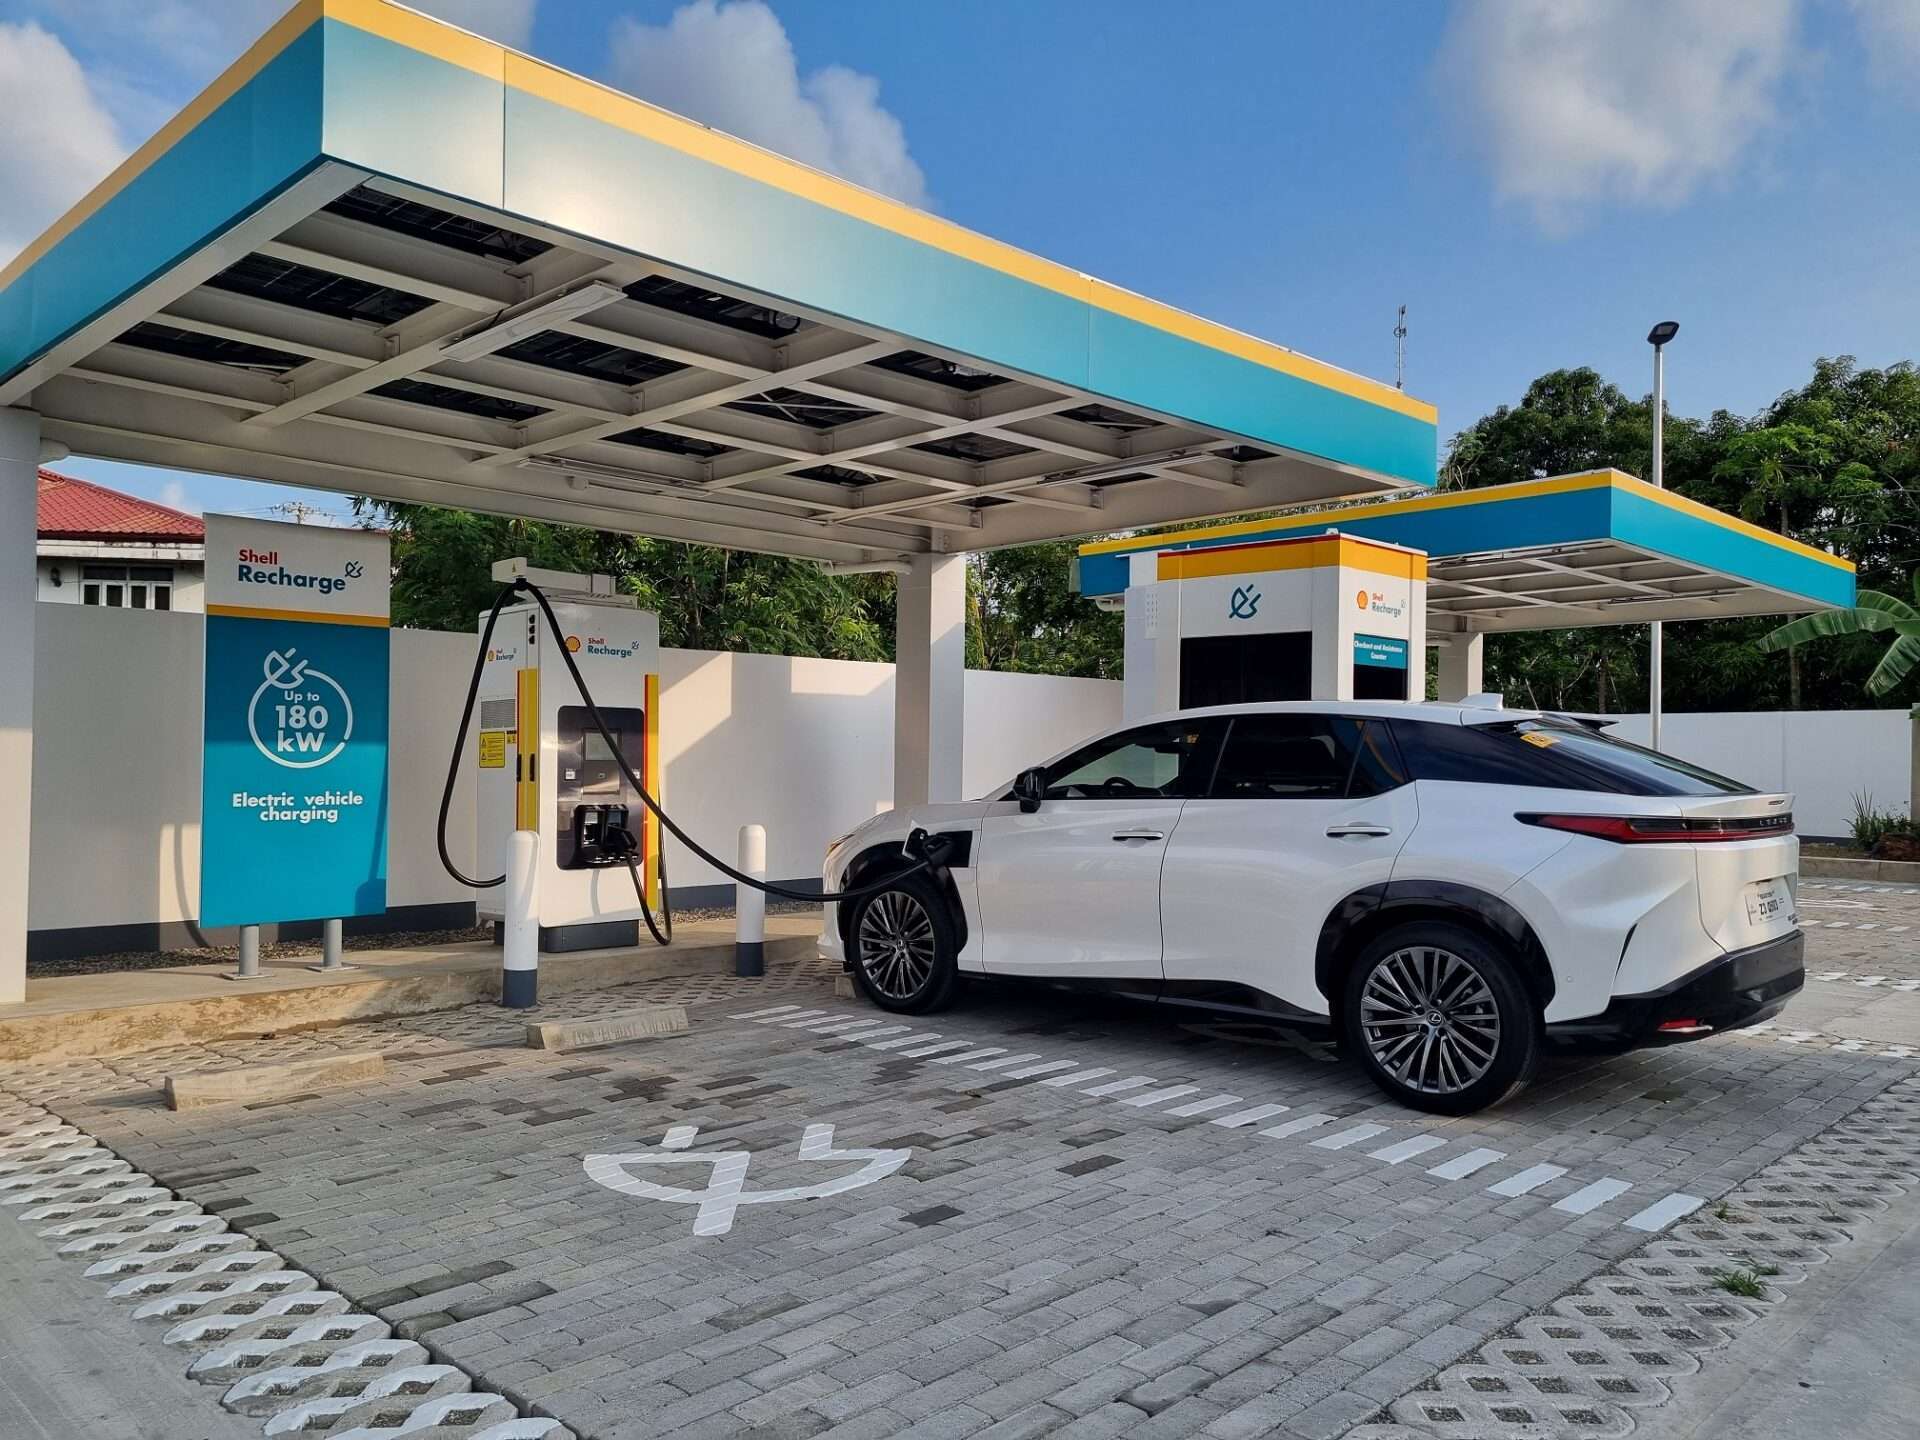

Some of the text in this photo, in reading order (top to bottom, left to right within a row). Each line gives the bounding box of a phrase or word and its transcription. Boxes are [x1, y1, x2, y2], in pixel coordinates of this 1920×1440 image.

[239, 549, 278, 565] Shell
[238, 564, 346, 594] Recharge
[1372, 602, 1401, 618] Recharge
[588, 637, 605, 645] Shell
[588, 645, 632, 658] Recharge
[284, 690, 320, 704] Up to
[275, 705, 329, 729] 180
[277, 730, 325, 752] kW
[232, 791, 363, 807] Electric vehicle
[260, 805, 338, 823] charging
